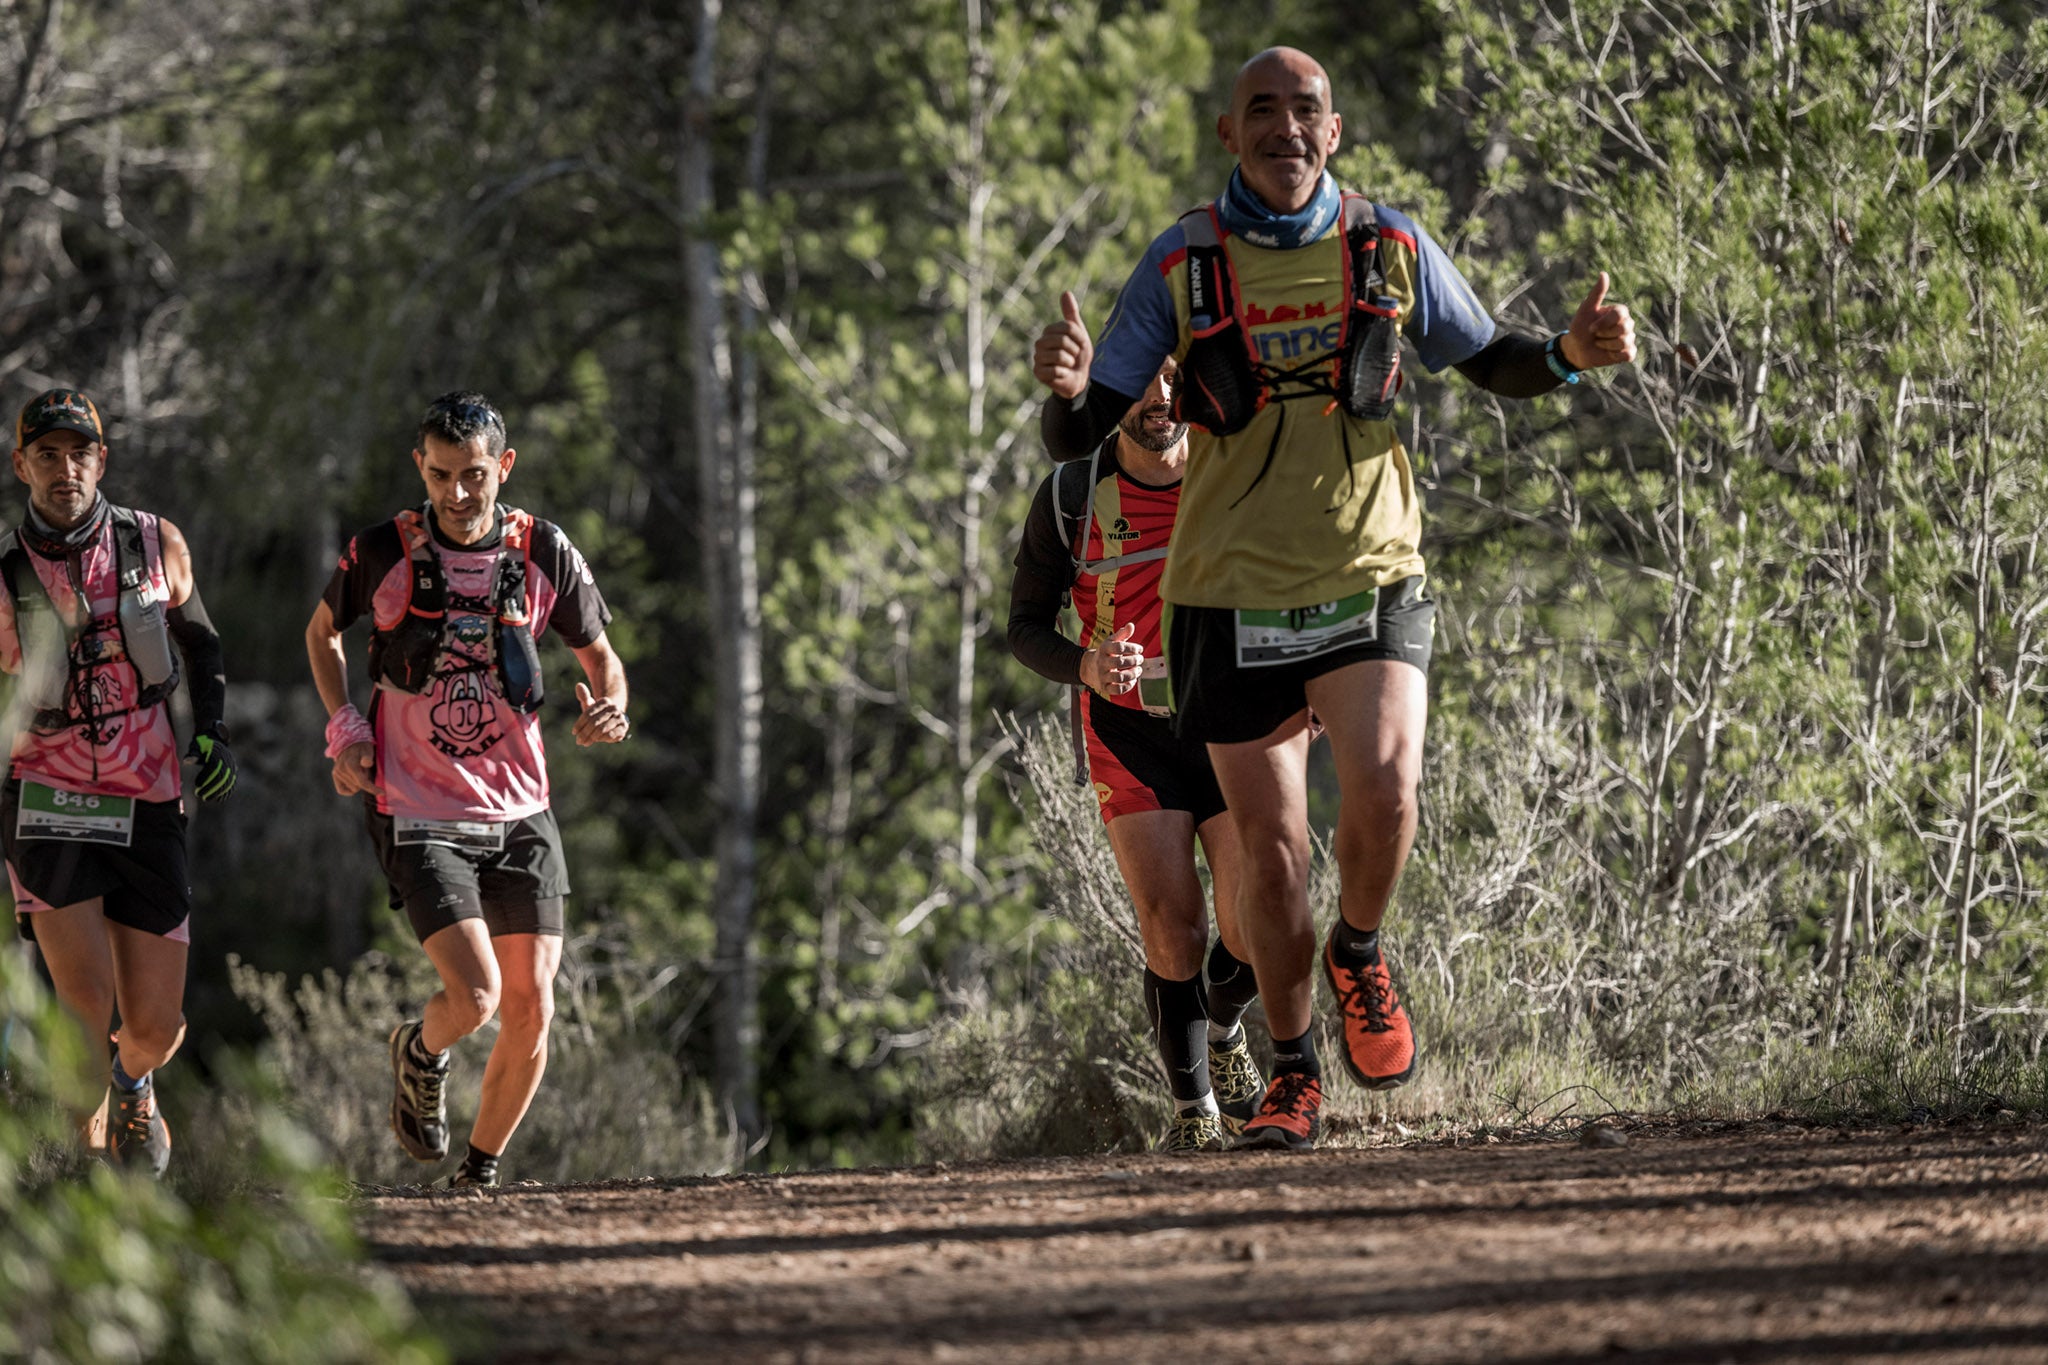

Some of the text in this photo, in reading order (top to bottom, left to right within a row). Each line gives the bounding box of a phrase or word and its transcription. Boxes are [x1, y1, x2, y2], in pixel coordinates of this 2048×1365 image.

[1108, 531, 1140, 540] VIATOR
[428, 730, 505, 759] TRAIL
[53, 789, 101, 809] 846
